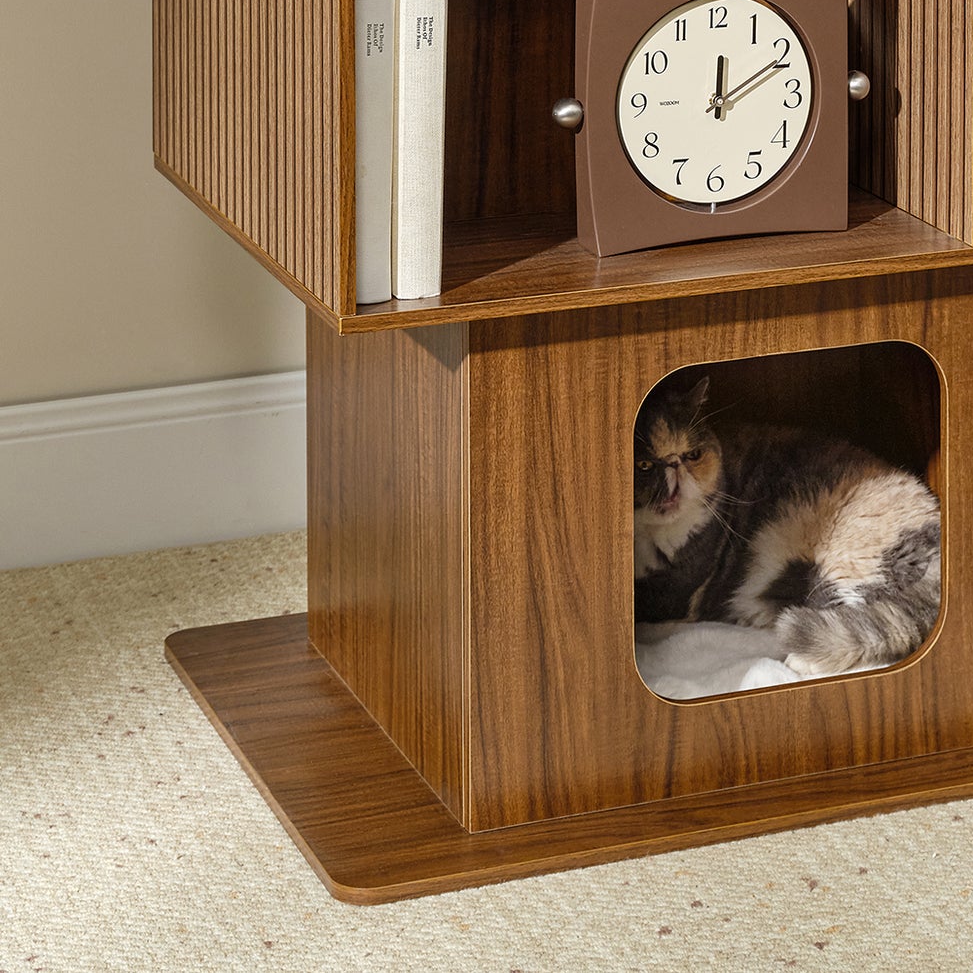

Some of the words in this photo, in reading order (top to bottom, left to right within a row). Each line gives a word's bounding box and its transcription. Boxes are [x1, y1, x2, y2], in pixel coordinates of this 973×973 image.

[674, 18, 687, 42] 11
[708, 6, 729, 29] 12
[749, 13, 758, 45] 1
[643, 50, 668, 75] 10
[772, 38, 791, 69] 2
[631, 93, 648, 118] 9
[783, 78, 801, 109] 3
[642, 132, 660, 158] 8
[770, 119, 790, 149] 4
[672, 158, 690, 185] 7
[706, 164, 725, 193] 6
[744, 149, 762, 180] 5
